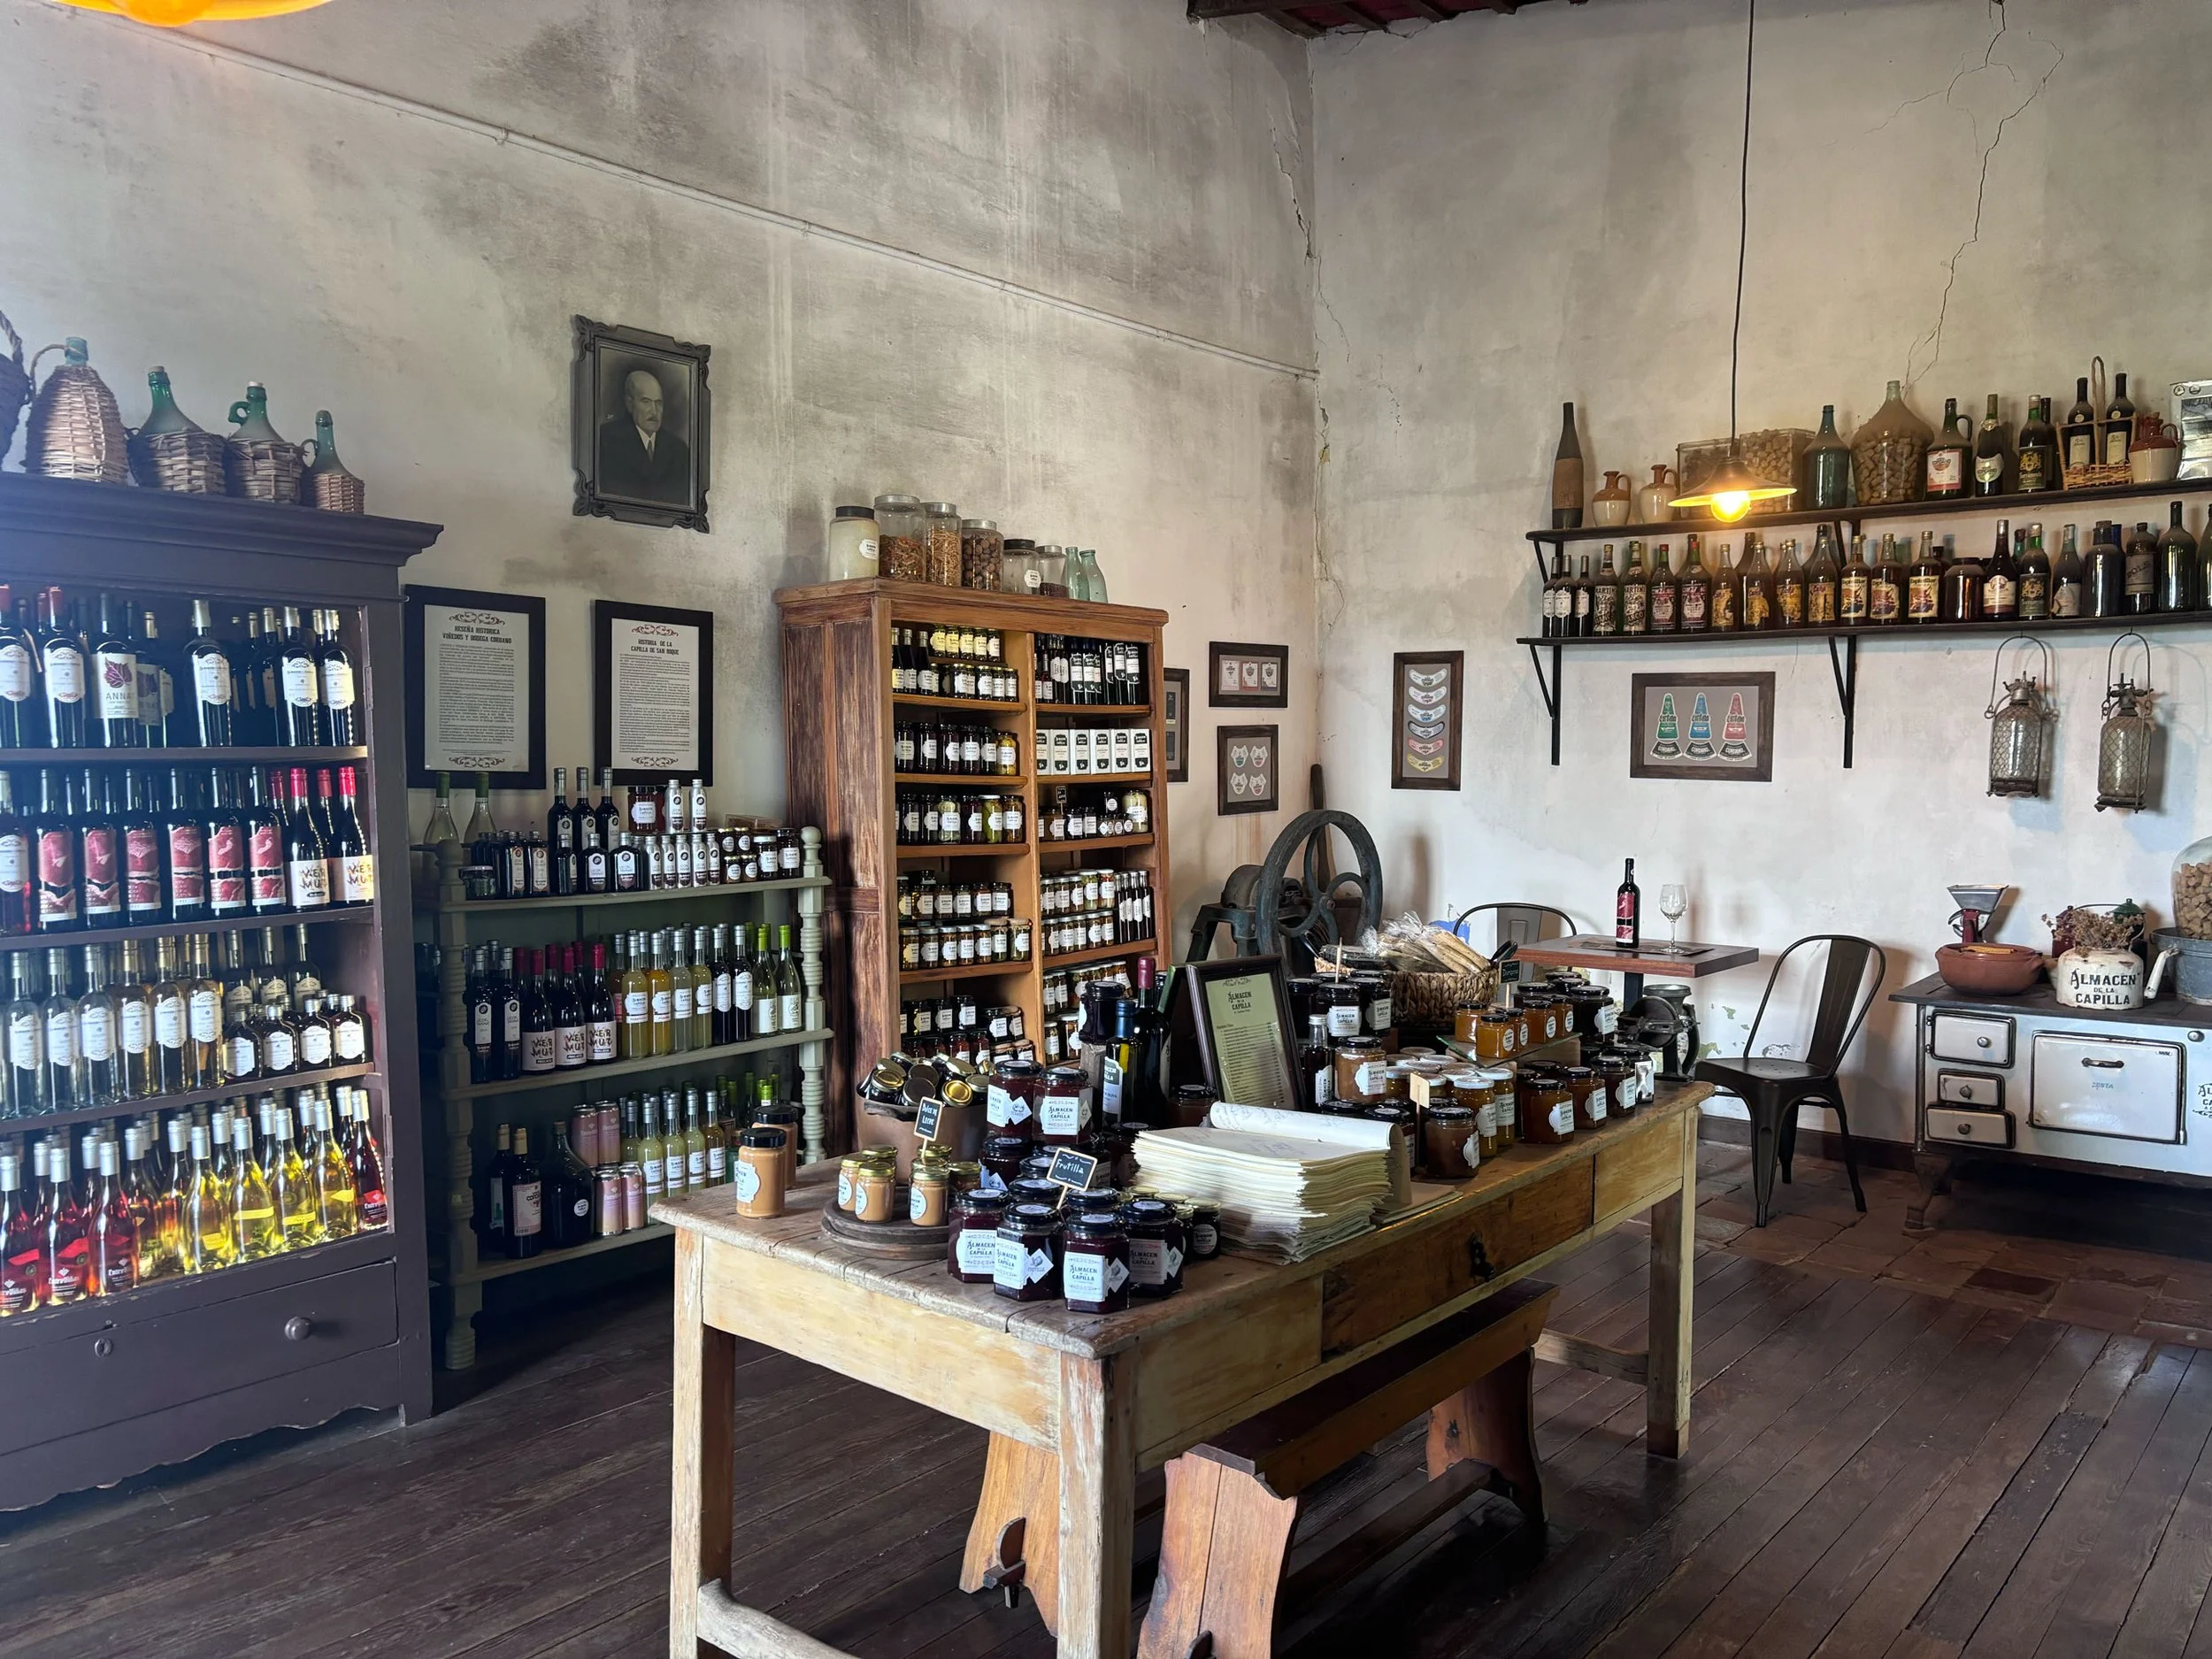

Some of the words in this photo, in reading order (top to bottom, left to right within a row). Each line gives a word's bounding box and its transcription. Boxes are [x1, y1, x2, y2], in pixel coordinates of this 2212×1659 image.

[2070, 968, 2137, 989] ALMACEN
[2076, 993, 2131, 1005] CAPILLA
[1048, 1105, 1073, 1114] ALMACEN
[1056, 1157, 1085, 1174] Frutilla
[967, 1240, 995, 1249] ALMACEN
[1070, 1263, 1098, 1273] ALMACEN
